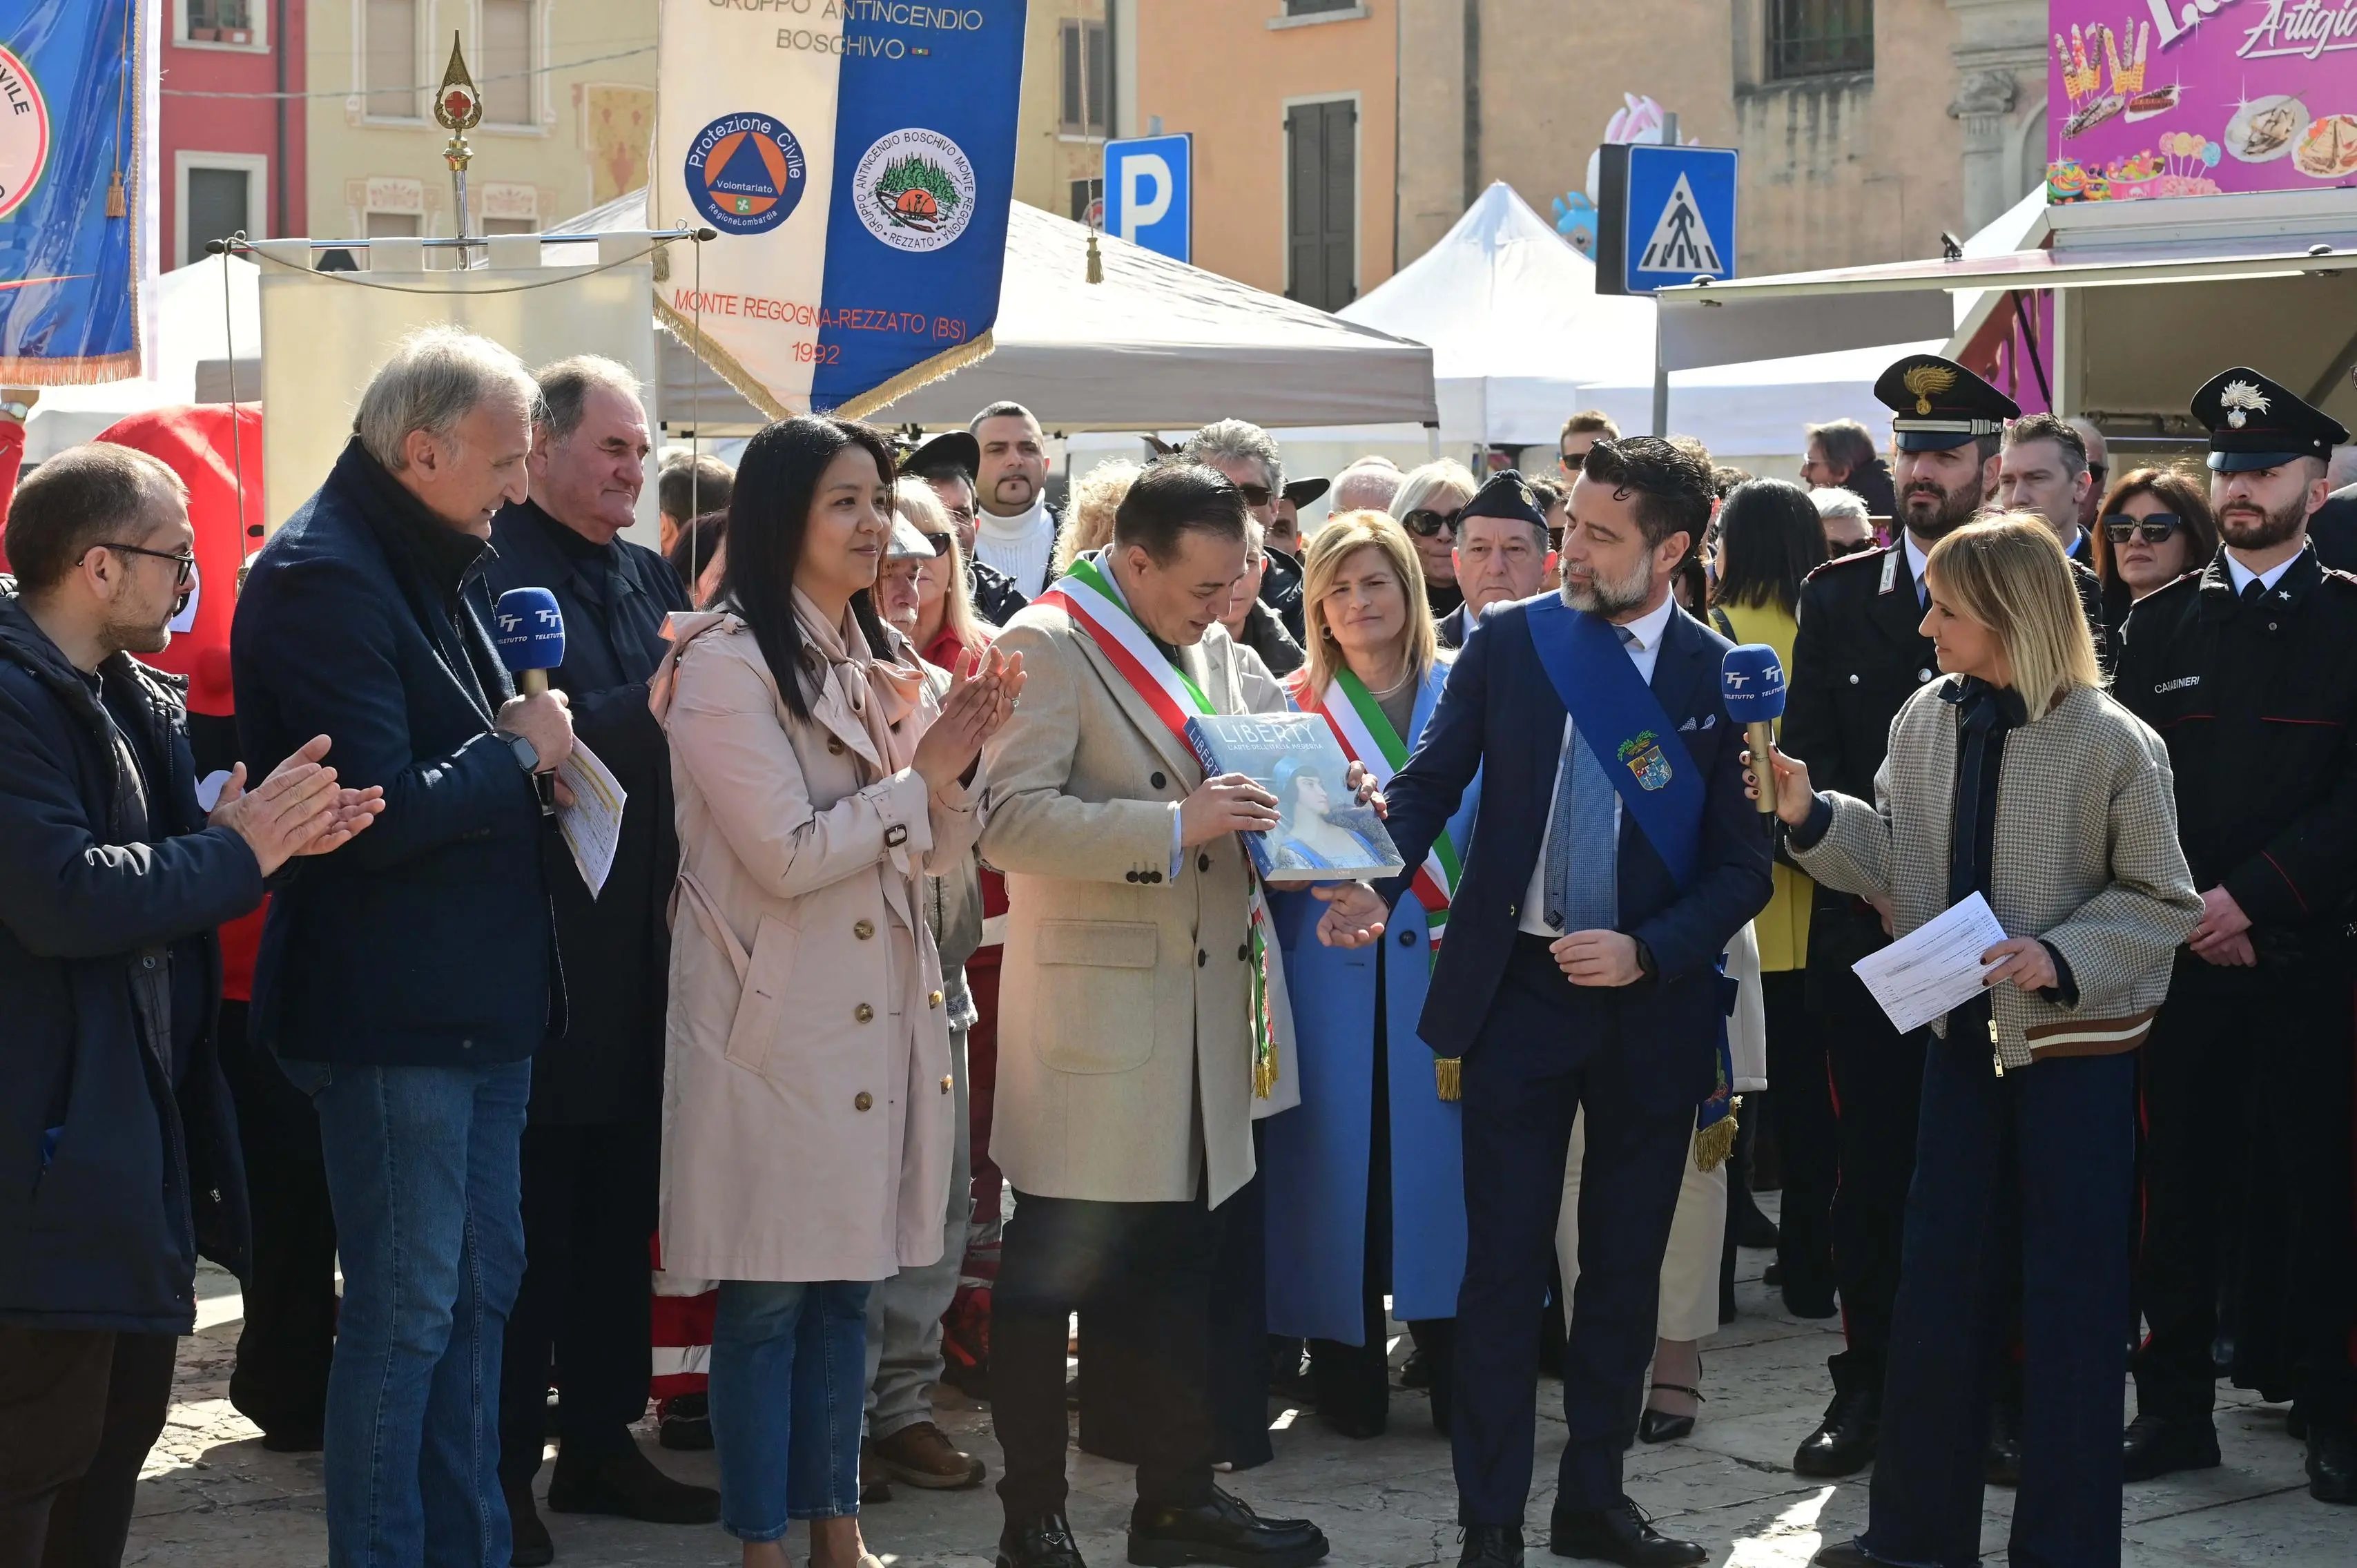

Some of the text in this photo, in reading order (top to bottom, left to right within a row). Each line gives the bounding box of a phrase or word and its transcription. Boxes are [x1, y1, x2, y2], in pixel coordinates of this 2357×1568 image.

[822, 0, 983, 30] ANTINCENDIO
[776, 28, 905, 59] BOSCHIVO
[0, 64, 30, 115] VILE
[688, 116, 803, 179] Protezione Civile
[716, 180, 773, 194] Volontariato
[856, 132, 974, 241] GRUPPO ANTINCENDIO BOSCHIVO MONTE REGOGNA
[1121, 153, 1173, 244] P
[889, 232, 935, 249] REZZATO
[674, 289, 738, 315] MONTE
[933, 316, 966, 345] (BS)
[792, 341, 840, 365] 1992
[497, 635, 527, 646] TELETUTTO
[1762, 684, 1785, 697] TELETUT
[1216, 722, 1315, 744] LIBERTY
[1189, 726, 1221, 777] LIBERT
